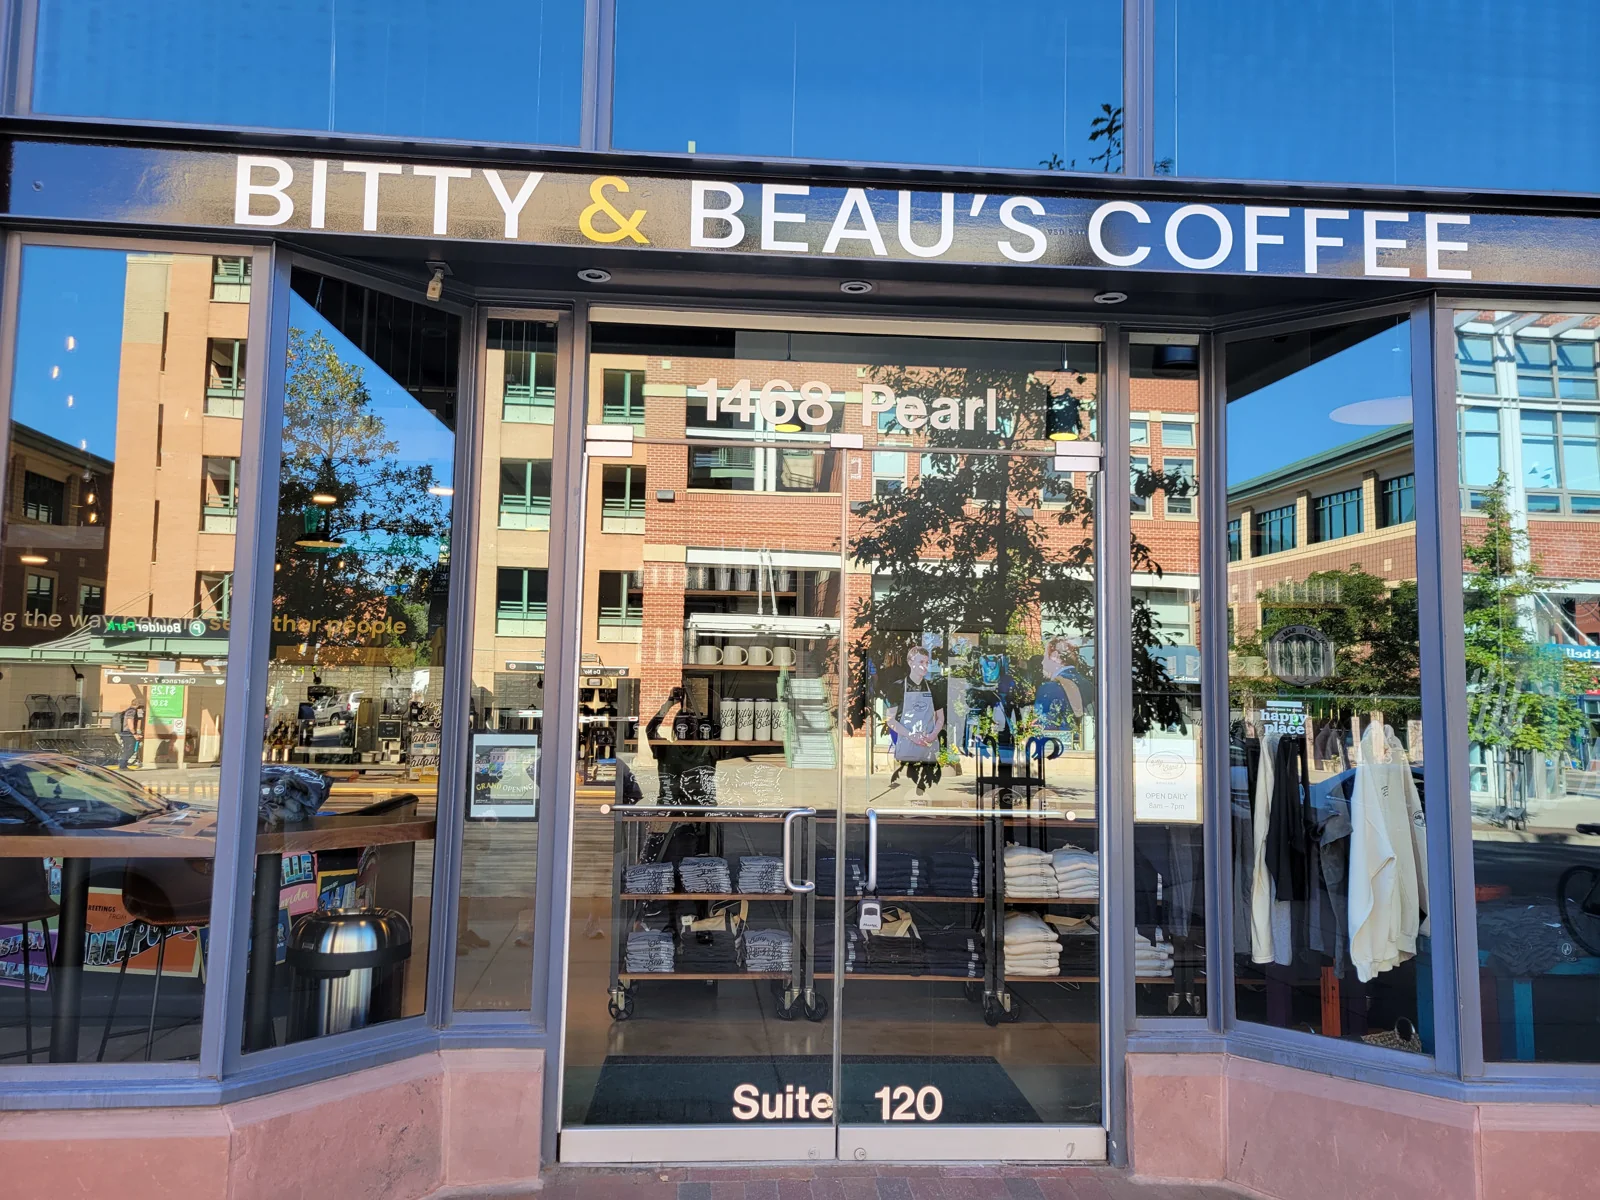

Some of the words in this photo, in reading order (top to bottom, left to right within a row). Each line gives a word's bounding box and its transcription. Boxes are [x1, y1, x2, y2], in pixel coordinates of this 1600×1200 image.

[234, 155, 544, 239] BITTY
[578, 175, 650, 244] &
[690, 180, 1048, 263] BEAU'S
[1088, 200, 1472, 280] COFFEE
[697, 378, 833, 426] 1468
[862, 384, 996, 431] Pearl
[24, 608, 62, 628] the
[70, 614, 115, 634] way
[326, 615, 407, 639] people
[1259, 709, 1307, 725] happy
[1264, 722, 1305, 735] place
[476, 782, 501, 791] GRAND
[502, 782, 534, 793] OPENING
[1145, 792, 1166, 800] OPEN
[1167, 792, 1188, 800] DAILY
[281, 854, 313, 886] LLE
[87, 904, 116, 913] REETINGS
[732, 1083, 833, 1120] Suite
[874, 1085, 943, 1121] 120
